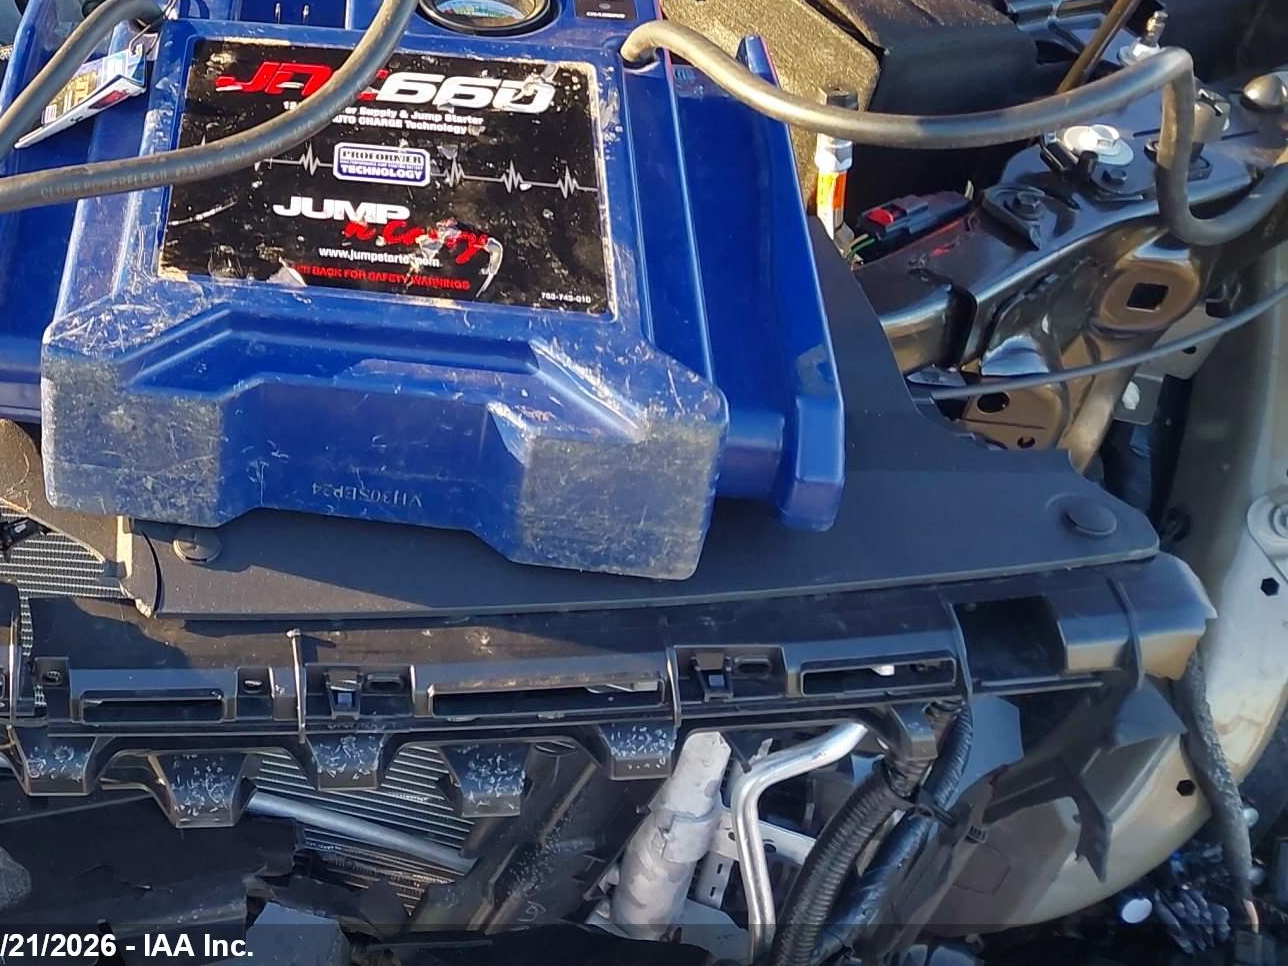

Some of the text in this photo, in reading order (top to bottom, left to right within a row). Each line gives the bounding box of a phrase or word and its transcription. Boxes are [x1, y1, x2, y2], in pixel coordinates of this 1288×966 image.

[359, 107, 398, 119] Supply
[399, 110, 409, 118] &
[411, 112, 443, 122] Jump
[445, 114, 484, 125] Starter
[358, 117, 403, 129] CHARGE
[404, 120, 468, 135] Technology
[340, 164, 423, 180] TECHNOLOGY
[273, 196, 411, 224] JUMP
[344, 269, 366, 280] FOR
[368, 272, 409, 285] SAFETY
[411, 275, 472, 290] WARNINGS
